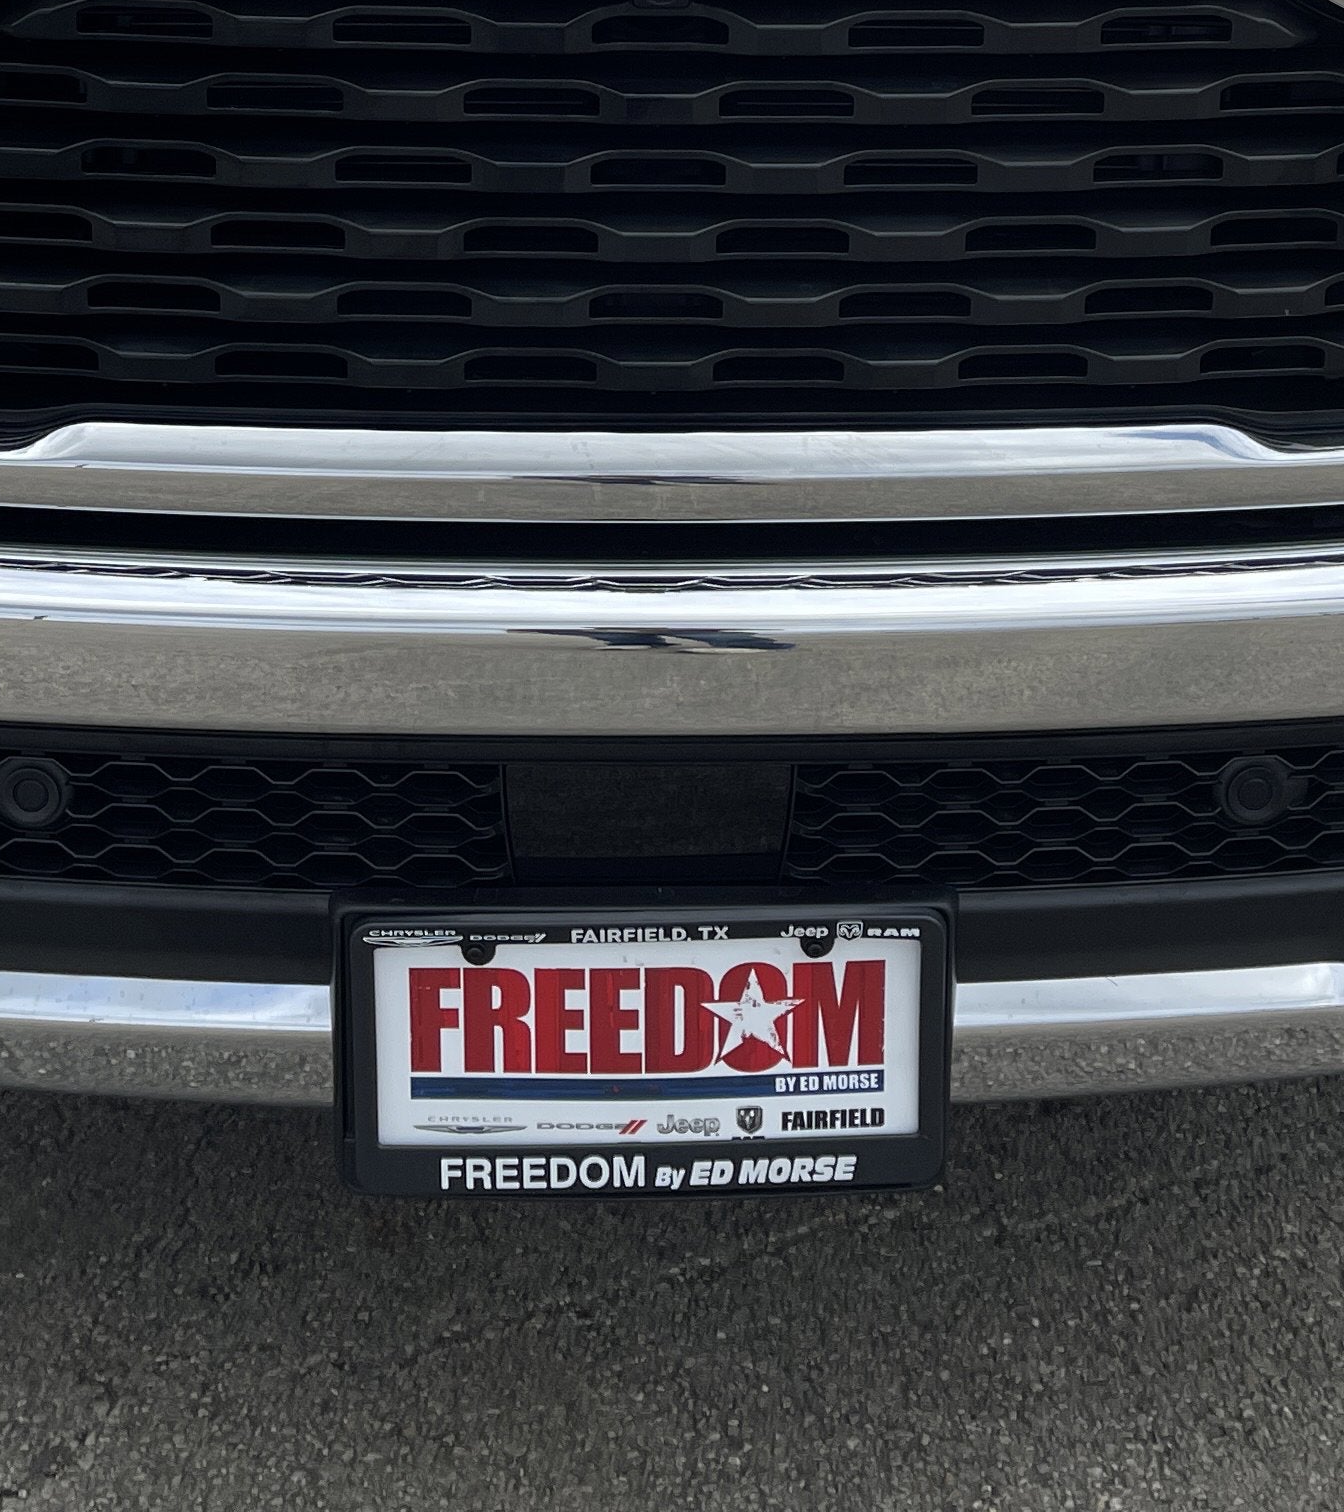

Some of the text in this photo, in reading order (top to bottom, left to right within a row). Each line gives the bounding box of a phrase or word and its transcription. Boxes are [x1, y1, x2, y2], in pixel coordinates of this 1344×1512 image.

[368, 929, 457, 937] CHRYSLER
[697, 925, 730, 940] TX
[779, 924, 829, 938] Jeep
[867, 928, 920, 937] RAM
[409, 962, 884, 1073] FREEDOM
[776, 1073, 879, 1093] BY ED MORSE
[427, 1115, 514, 1124] CHRYSLER
[657, 1114, 719, 1135] Jeep
[781, 1107, 885, 1131] FAIRFIELD
[440, 1155, 858, 1190] FREEDOM By ED MORSE
